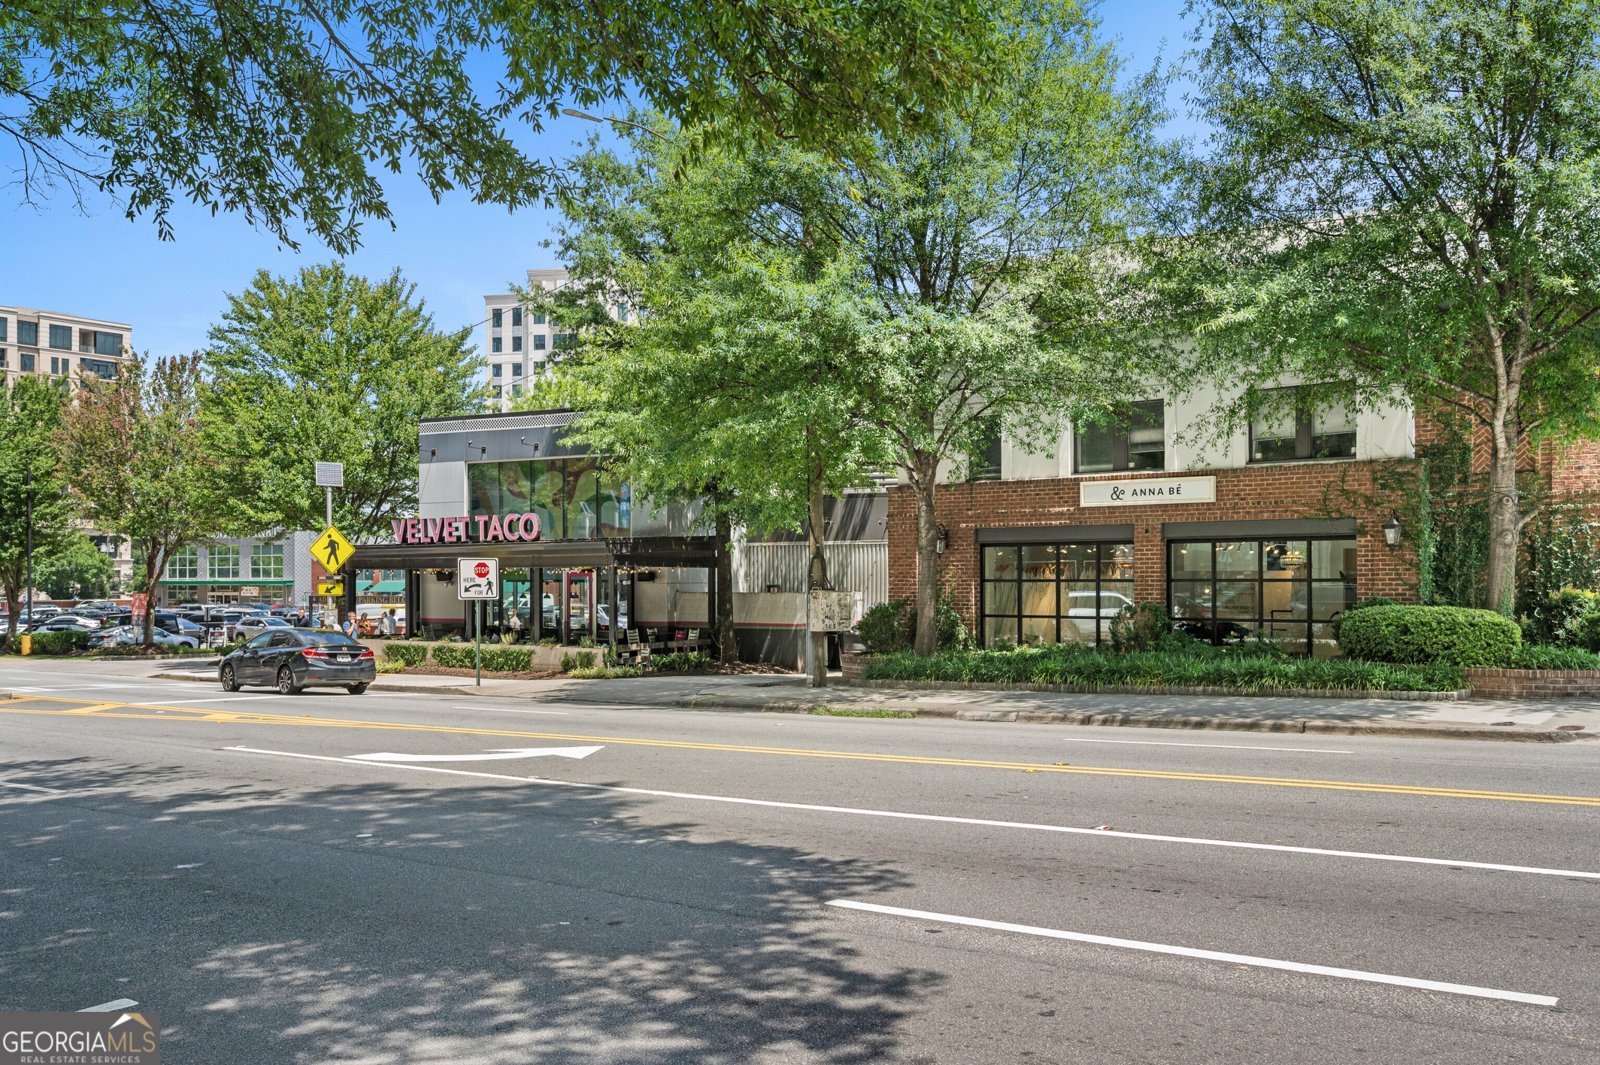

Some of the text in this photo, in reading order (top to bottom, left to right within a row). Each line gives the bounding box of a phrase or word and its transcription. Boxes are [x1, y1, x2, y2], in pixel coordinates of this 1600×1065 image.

[1131, 487, 1164, 497] ANNA
[1168, 483, 1182, 495] BÉ
[391, 512, 541, 544] VELVET TACO
[474, 566, 490, 574] STOP
